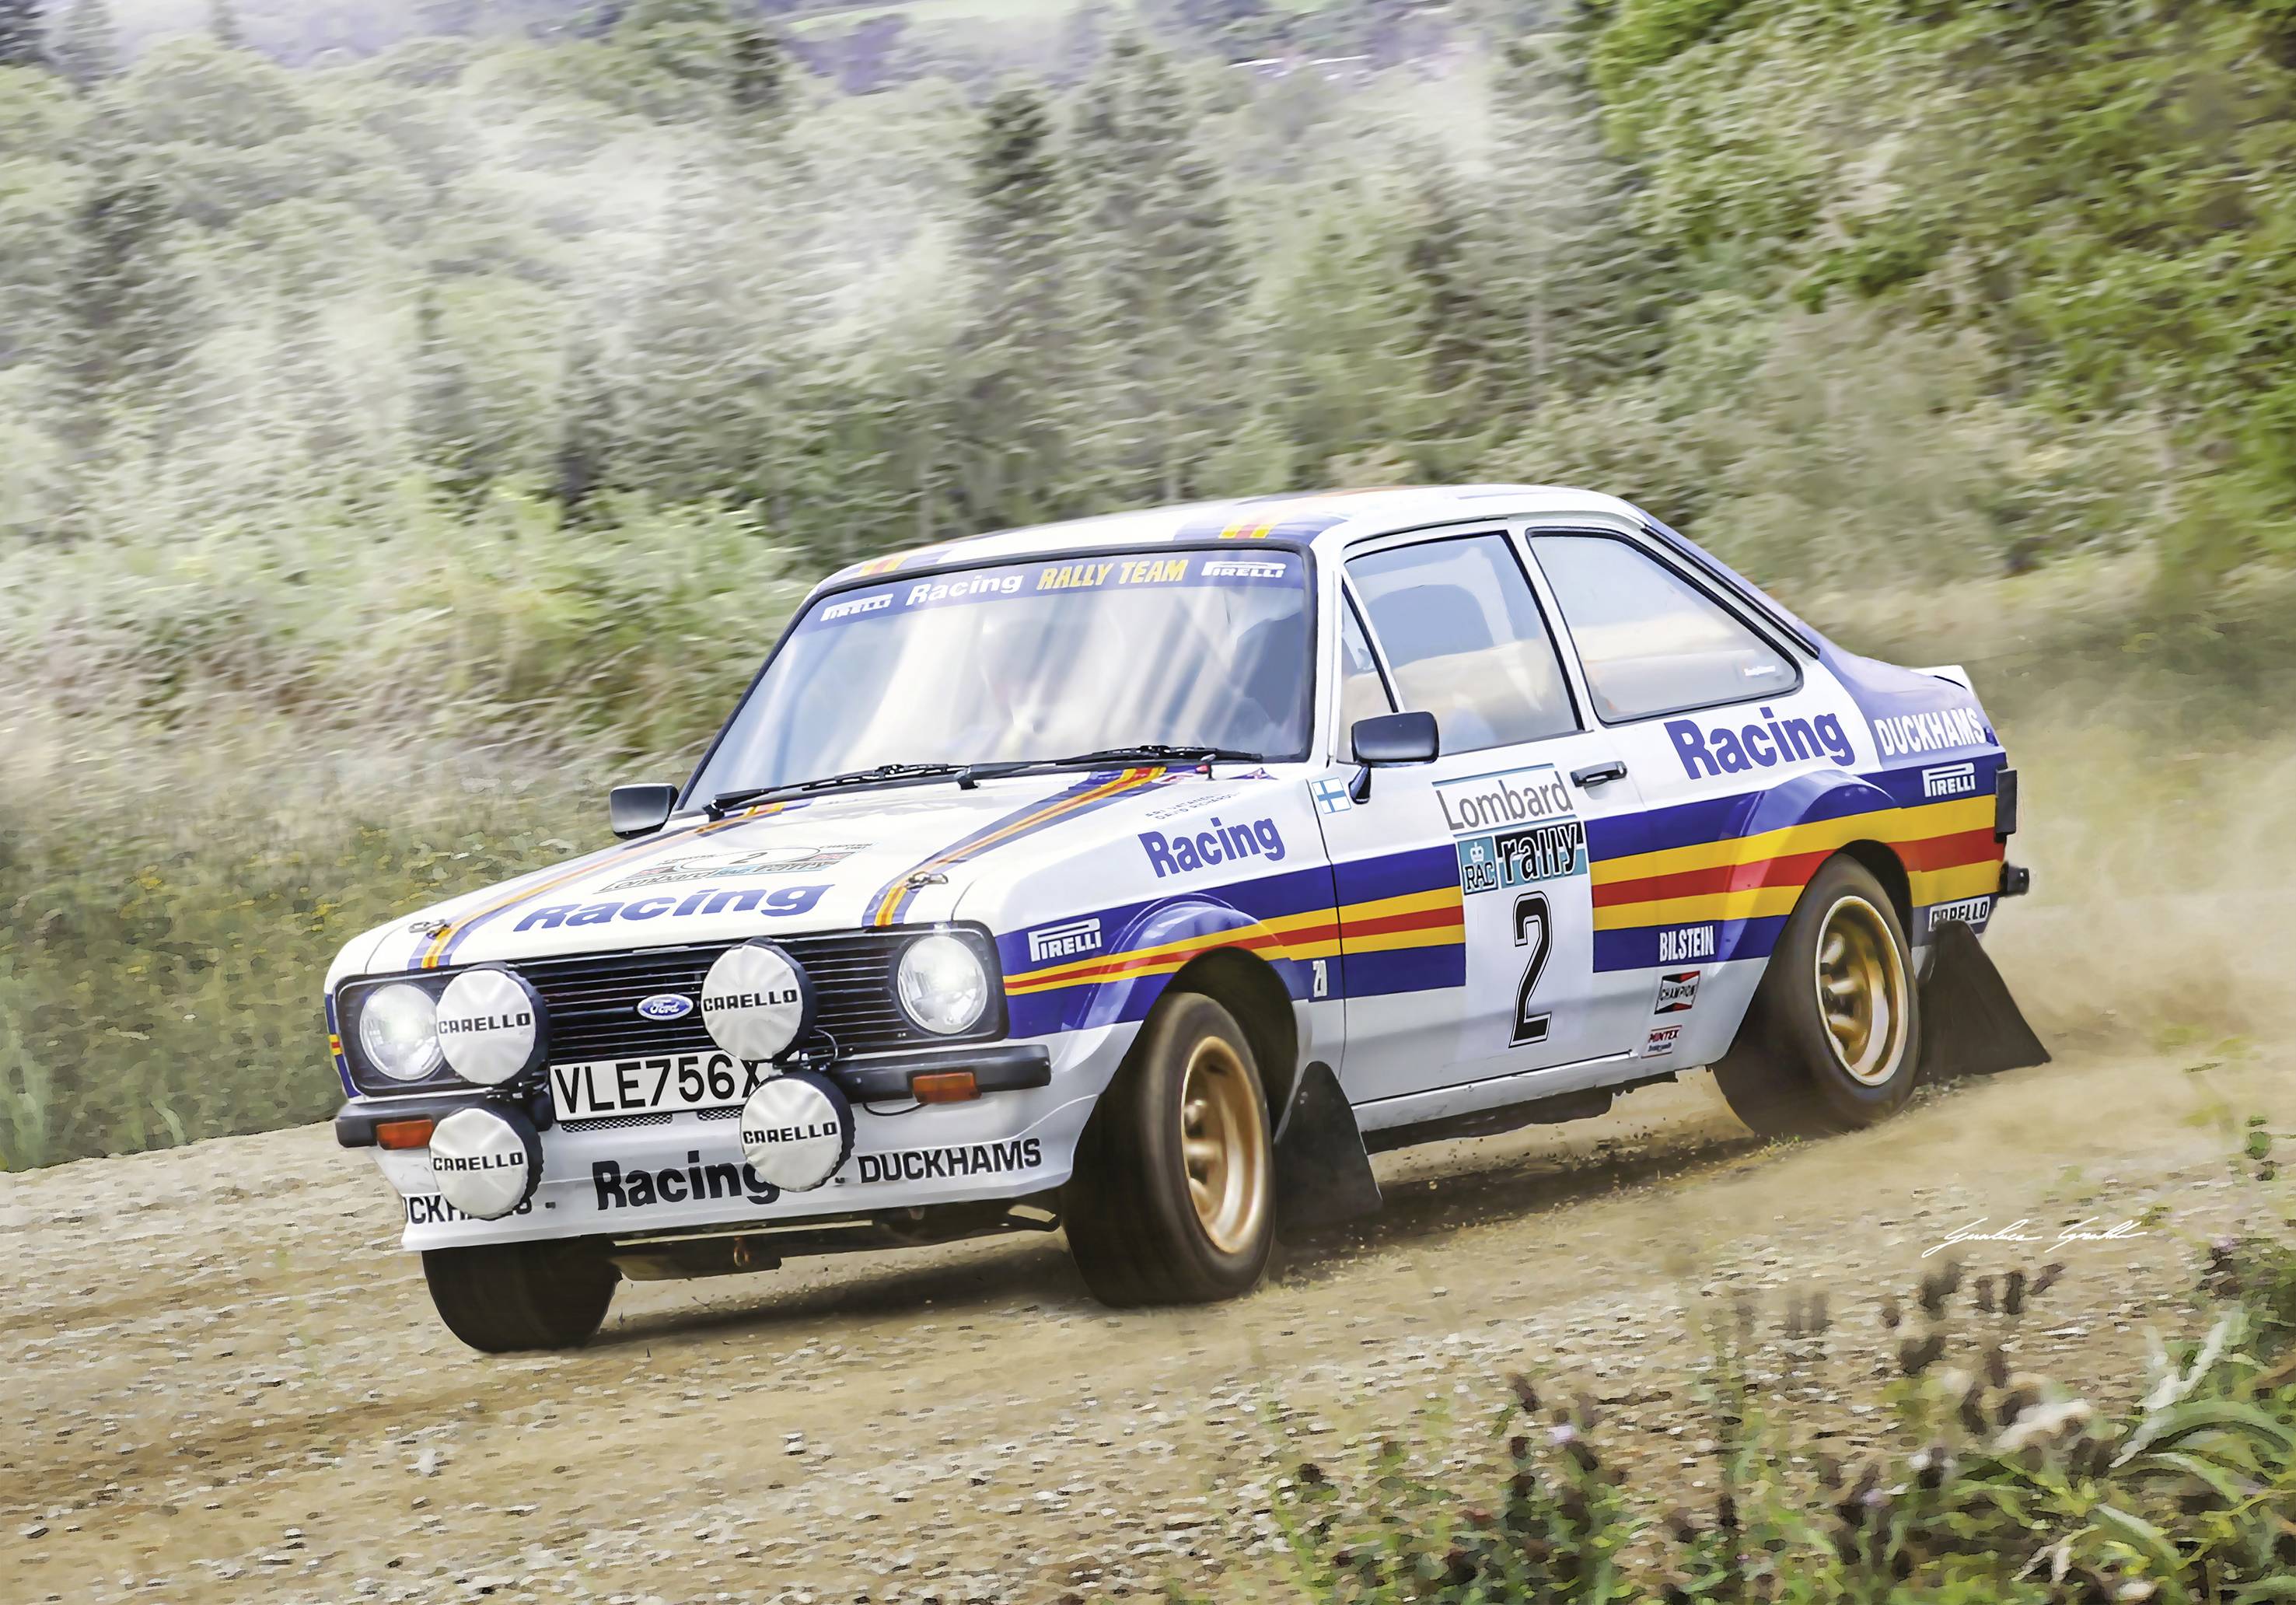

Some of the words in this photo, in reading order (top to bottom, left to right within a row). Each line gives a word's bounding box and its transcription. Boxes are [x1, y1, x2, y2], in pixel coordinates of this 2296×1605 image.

[906, 574, 1024, 606] Racing
[1036, 563, 1114, 590] RALLY
[1117, 559, 1189, 584] TEAM
[1201, 561, 1287, 578] PIRELLI
[1664, 706, 1856, 780] Racing
[1874, 708, 1987, 756] DUCKHAMS
[1436, 771, 1574, 830] Lombard
[1921, 762, 1976, 798] PIRELLI
[1138, 817, 1286, 878] Racing
[1464, 862, 1495, 890] RAC
[1501, 823, 1578, 884] rally
[599, 869, 718, 892] Lombard
[512, 883, 835, 932] Racing
[1028, 918, 1103, 962] PIRELLI
[1659, 925, 1715, 962] BILSTEIN
[1508, 890, 1553, 1049] 2
[439, 1012, 531, 1035] CARELLO
[649, 999, 680, 1014] Ford
[704, 989, 798, 1012] CARELLO
[743, 1122, 838, 1145] CARELLO
[433, 1152, 524, 1172] CARELLO
[592, 1150, 781, 1211] Racing
[858, 1138, 1042, 1184] DUCKHAMS
